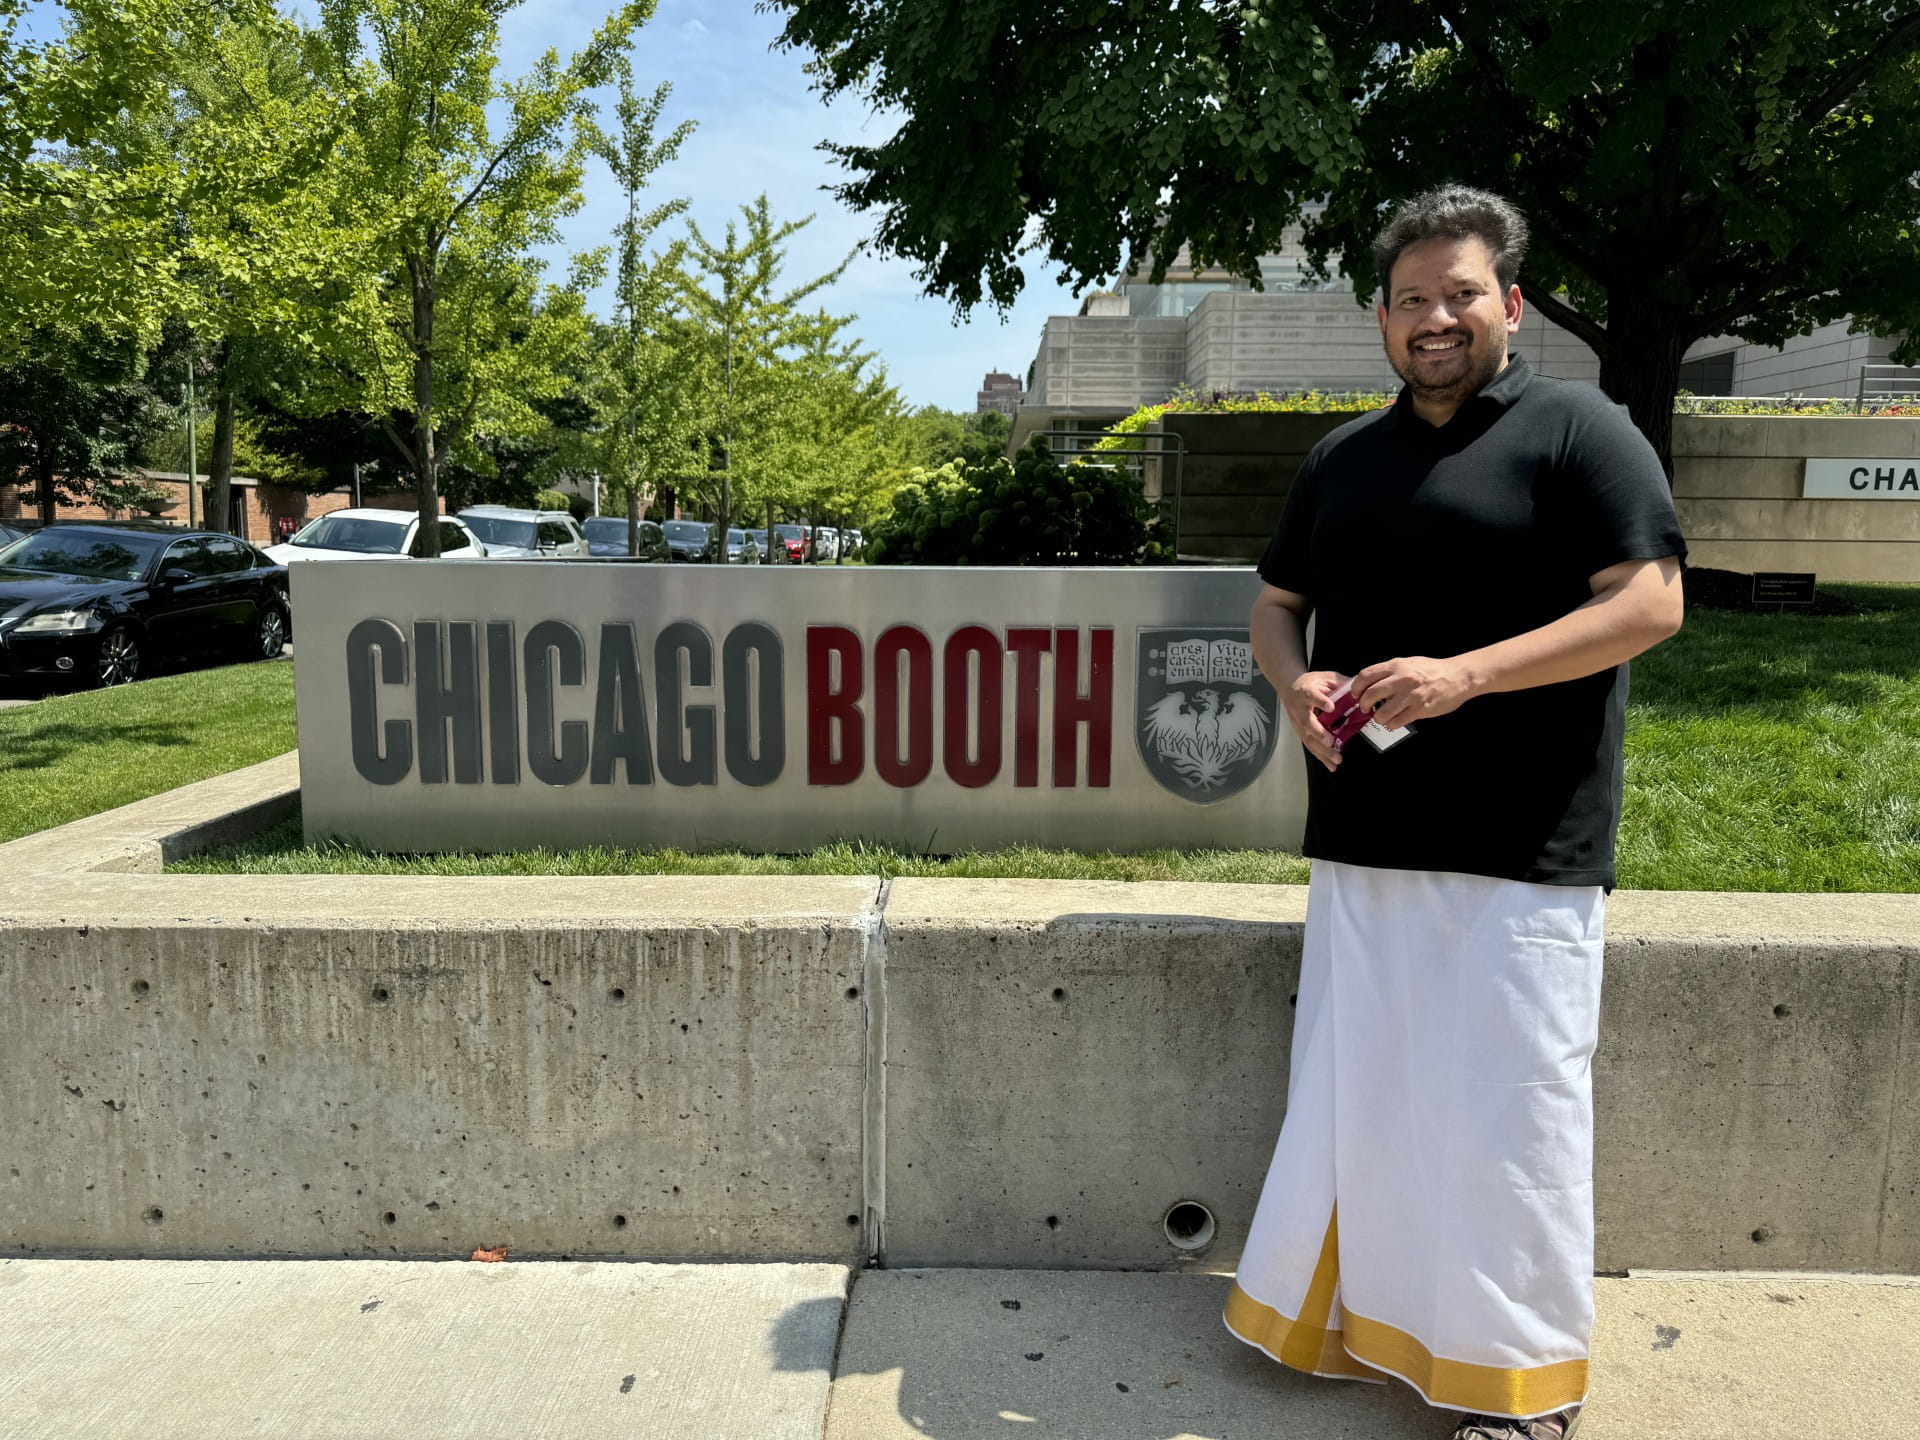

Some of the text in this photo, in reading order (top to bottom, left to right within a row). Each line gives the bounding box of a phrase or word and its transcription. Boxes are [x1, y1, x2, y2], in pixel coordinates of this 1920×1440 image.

[1216, 642, 1246, 657] Vita
[1170, 666, 1204, 678] entia
[1213, 667, 1248, 679] latur
[346, 618, 1114, 788] CHICAGO BOOTH
